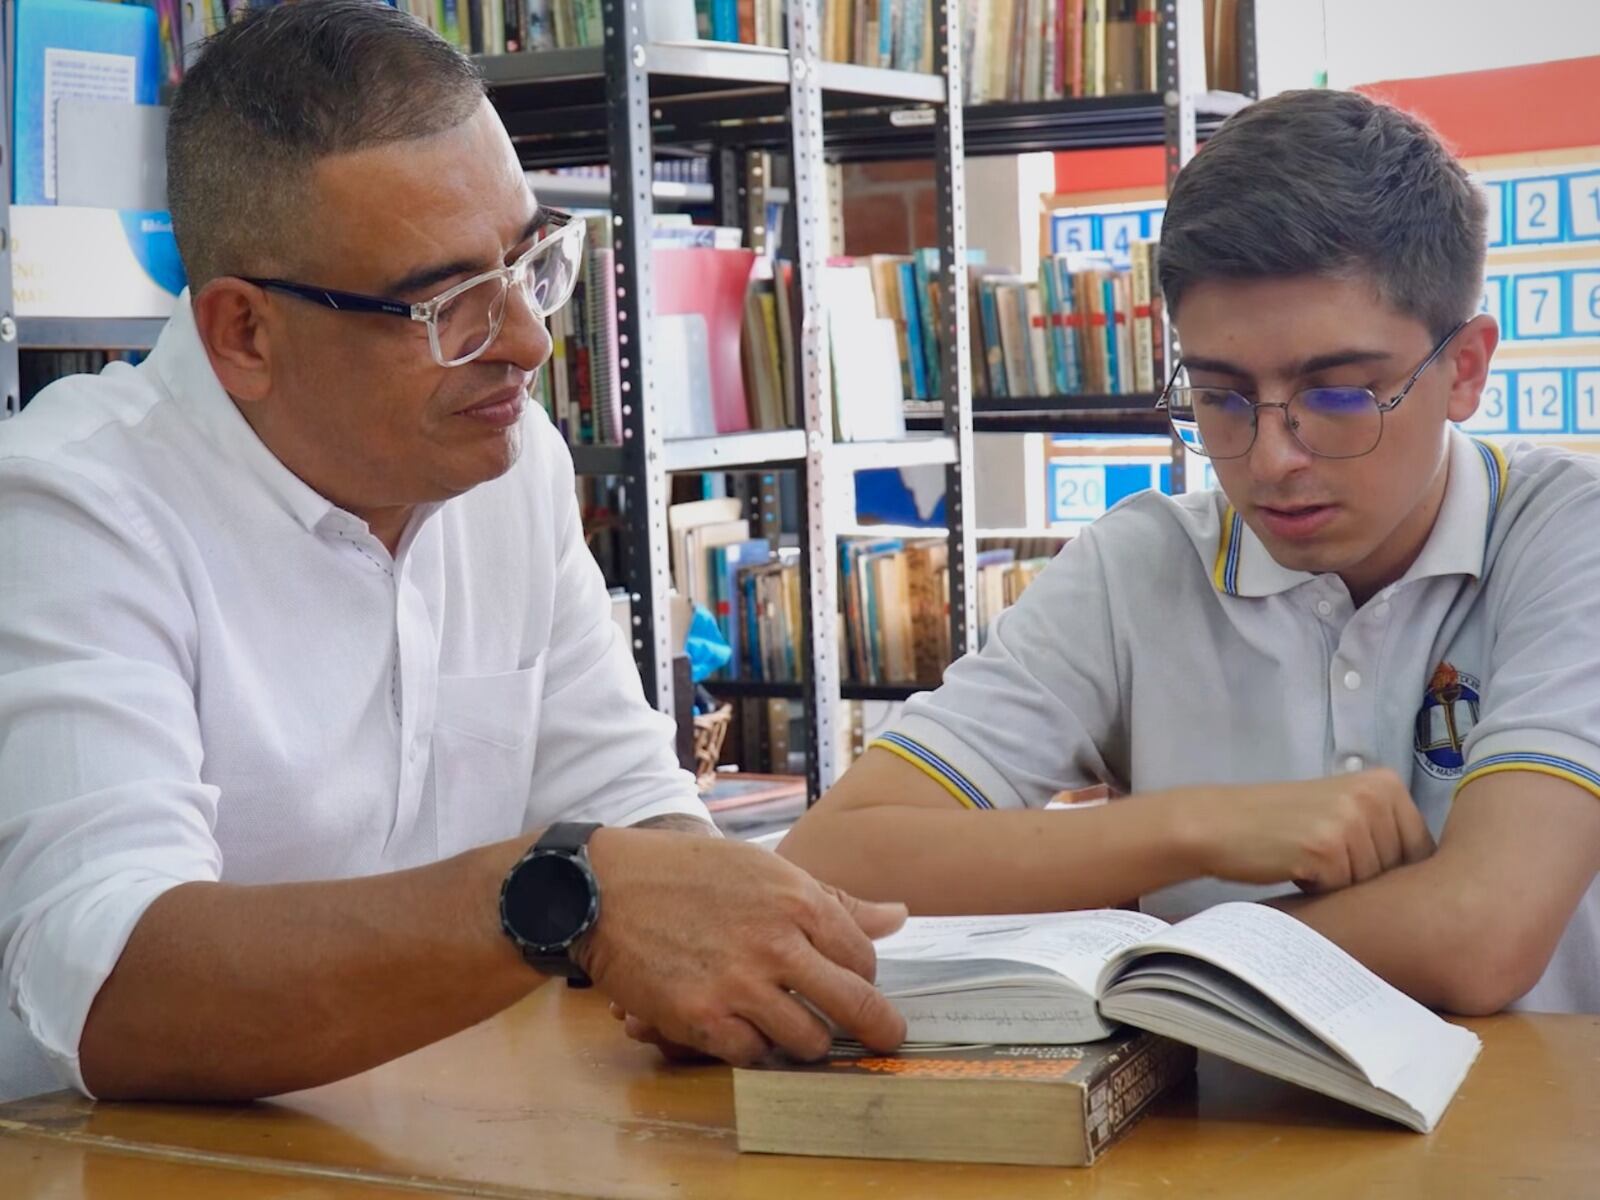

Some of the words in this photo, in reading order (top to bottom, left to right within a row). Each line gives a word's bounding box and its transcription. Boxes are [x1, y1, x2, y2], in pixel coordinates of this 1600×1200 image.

[1528, 192, 1547, 228] 2
[1066, 227, 1082, 252] 5
[1114, 225, 1131, 256] 4
[1530, 288, 1549, 324] 7
[1588, 284, 1600, 319] 6
[1484, 386, 1504, 419] 3
[1523, 384, 1558, 417] 12
[1583, 386, 1595, 417] 1
[1060, 479, 1101, 507] 20
